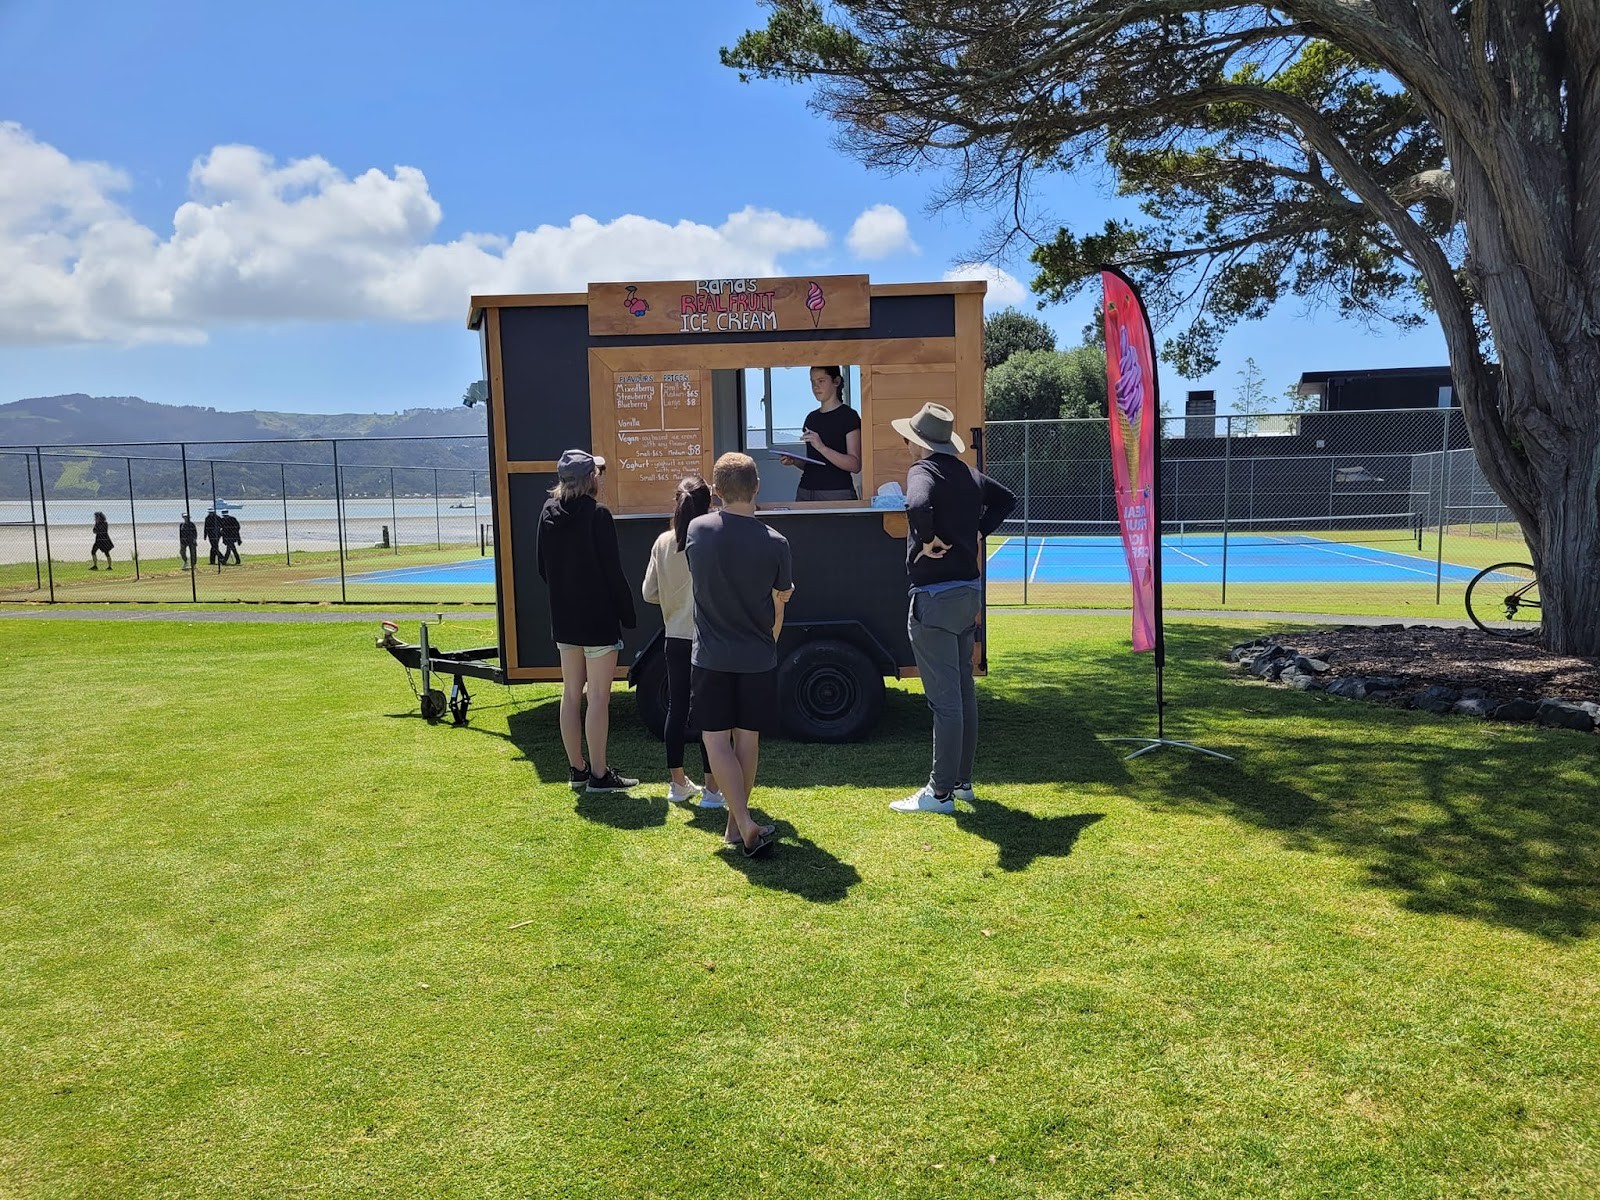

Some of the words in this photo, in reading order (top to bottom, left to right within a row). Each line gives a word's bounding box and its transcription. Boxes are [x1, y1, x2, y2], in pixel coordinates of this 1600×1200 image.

[696, 278, 757, 295] Rama's
[681, 294, 727, 314] REAL
[728, 291, 775, 312] FRUIT
[680, 313, 710, 332] ICE
[717, 311, 777, 331] CREAM
[619, 375, 654, 383] FLAVOURS
[663, 374, 689, 382] PRICES
[616, 383, 655, 395] Mixedberry
[617, 400, 648, 411] Blueberry
[618, 417, 640, 427] Vanilla
[619, 458, 649, 471] Yoghurt
